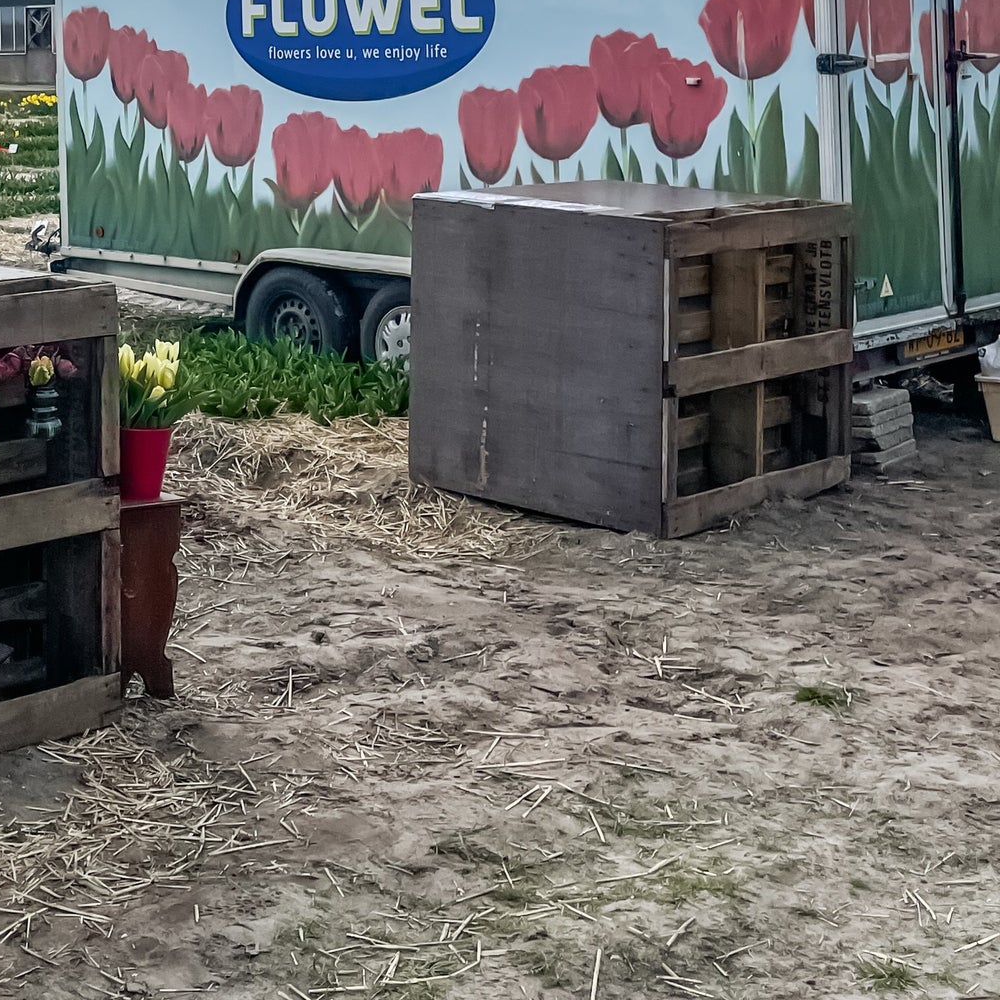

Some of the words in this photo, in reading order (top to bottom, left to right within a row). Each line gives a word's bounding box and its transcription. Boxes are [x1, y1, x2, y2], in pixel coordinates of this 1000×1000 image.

[268, 45, 312, 60] flowers
[316, 45, 341, 60] love
[346, 50, 357, 61] u,
[362, 48, 380, 59] we
[384, 46, 421, 61] enjoy
[425, 44, 448, 59] life
[819, 239, 833, 333] TENSVLOTB
